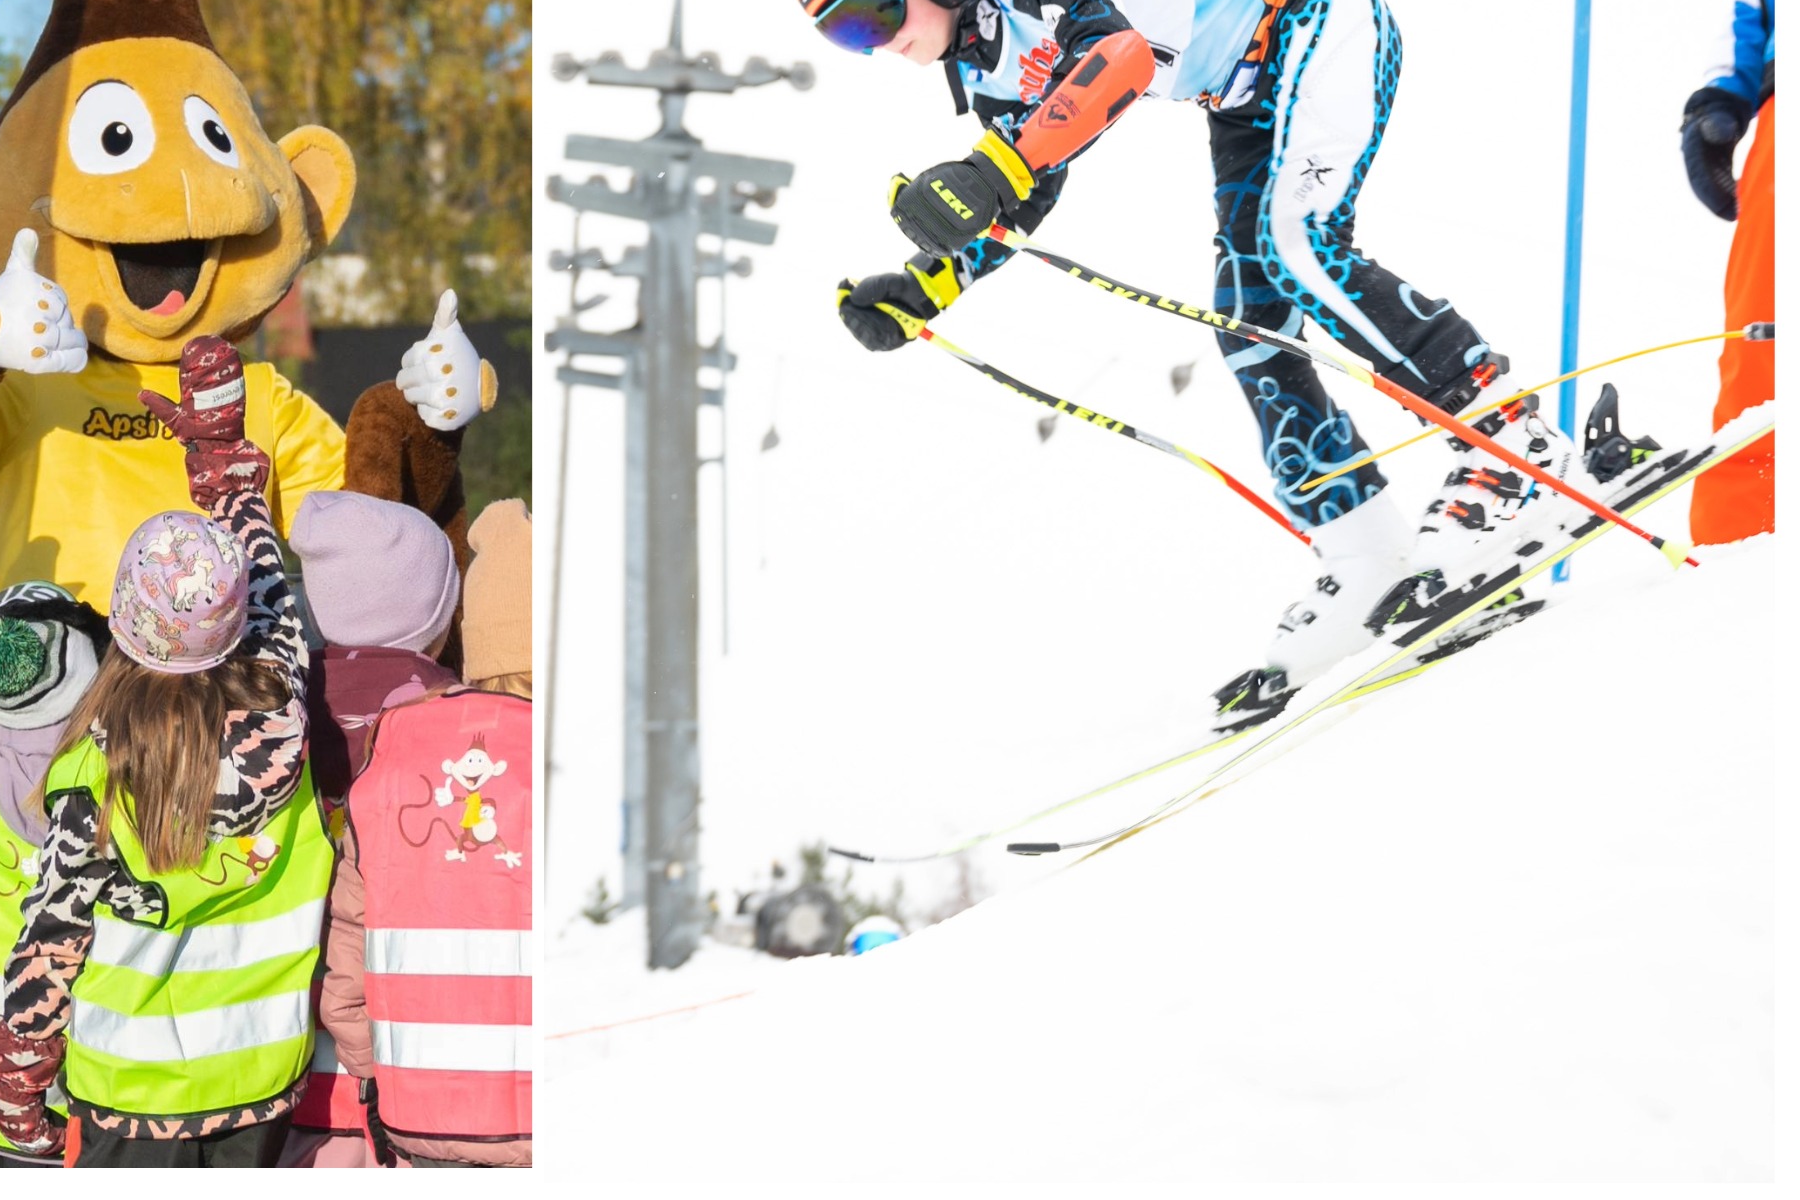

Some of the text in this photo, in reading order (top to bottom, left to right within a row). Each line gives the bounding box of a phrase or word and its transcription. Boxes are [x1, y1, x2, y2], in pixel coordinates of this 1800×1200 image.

[930, 179, 975, 220] LEKI
[1156, 295, 1242, 331] LEKI
[83, 407, 160, 441] Apsi
